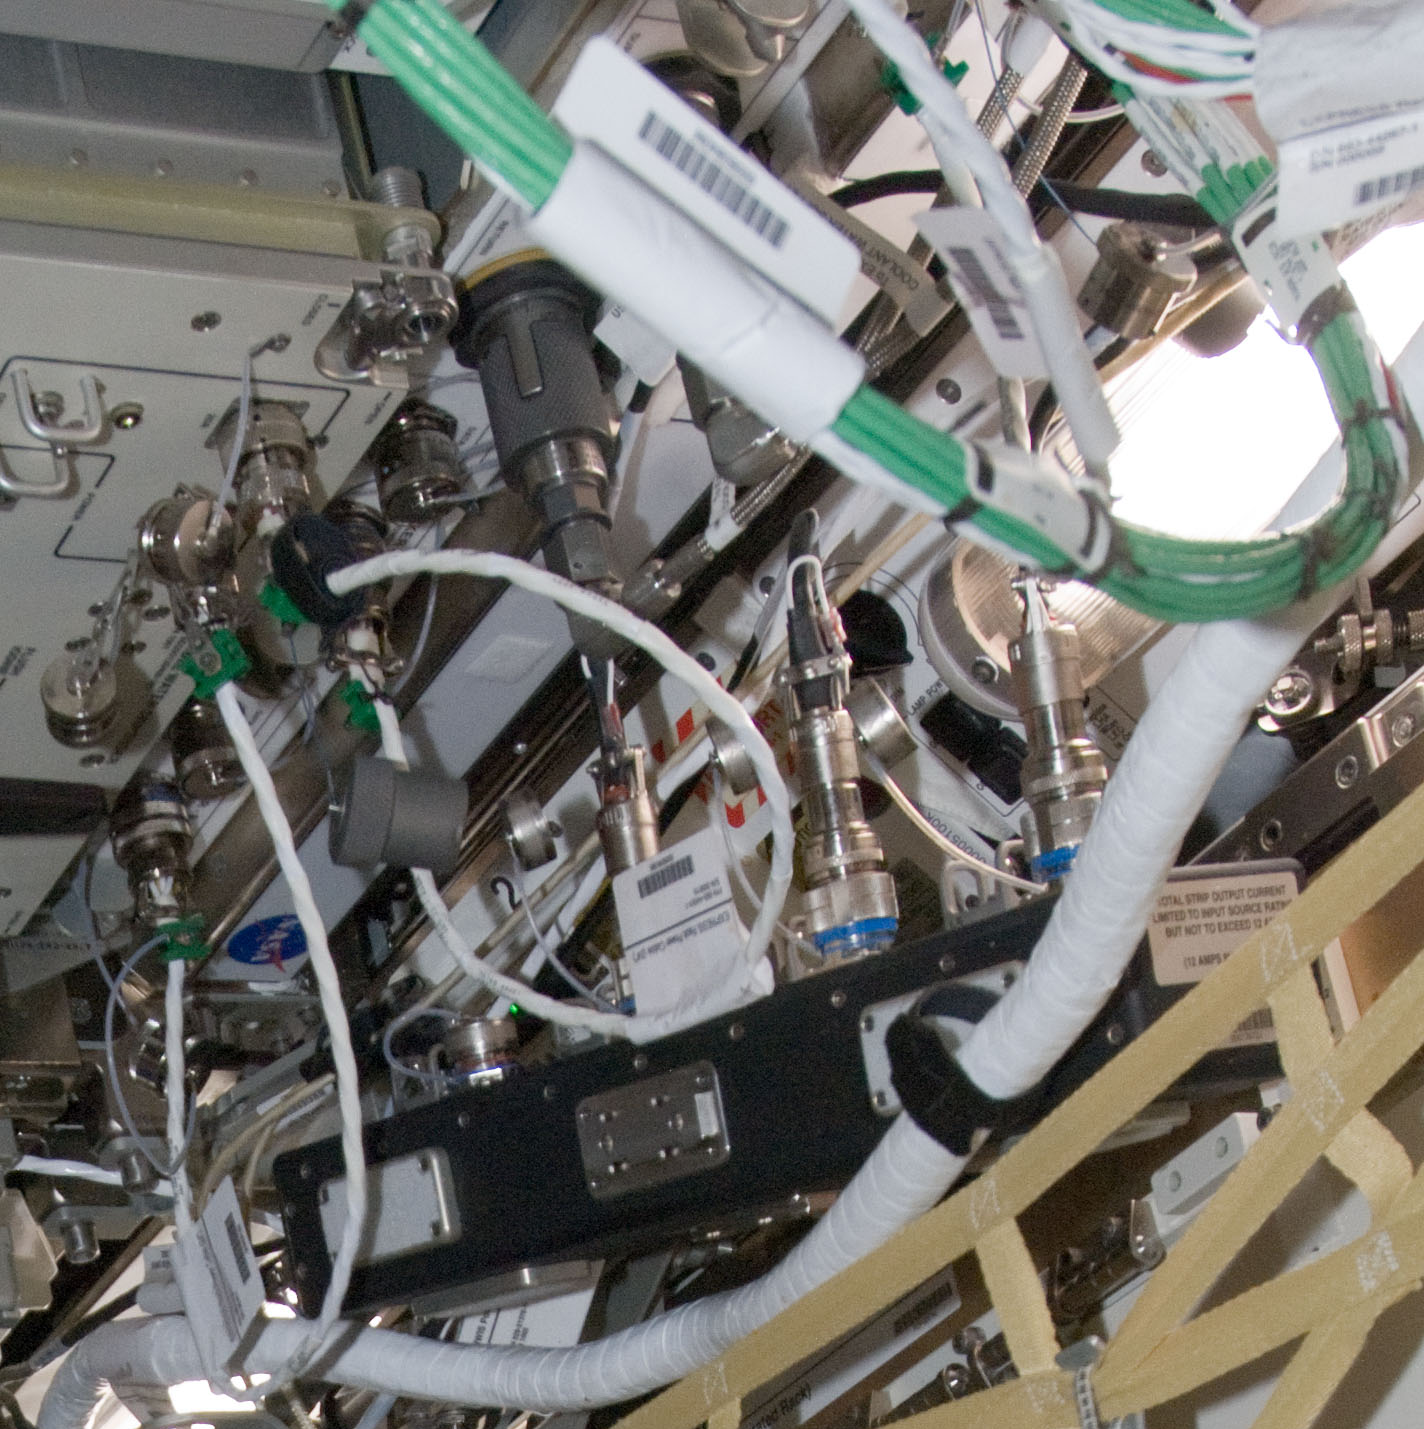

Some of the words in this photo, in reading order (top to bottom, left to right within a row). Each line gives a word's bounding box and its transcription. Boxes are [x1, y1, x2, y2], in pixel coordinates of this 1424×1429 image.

[906, 693, 928, 718] LAMP
[926, 679, 945, 700] POW
[1185, 892, 1210, 905] STRIP
[1212, 888, 1245, 901] OUTPUT
[1247, 884, 1286, 899] CURRENT
[1152, 910, 1186, 924] LIMITED
[1188, 907, 1200, 920] TO
[1201, 905, 1226, 919] INPUT
[1228, 901, 1262, 916] SOURCE
[1165, 925, 1183, 938] BUT
[1185, 922, 1202, 937] NOT
[1204, 921, 1217, 934] TO
[1217, 918, 1252, 934] EXCEED
[1253, 917, 1263, 929] 12
[1198, 953, 1223, 967] AMPS
